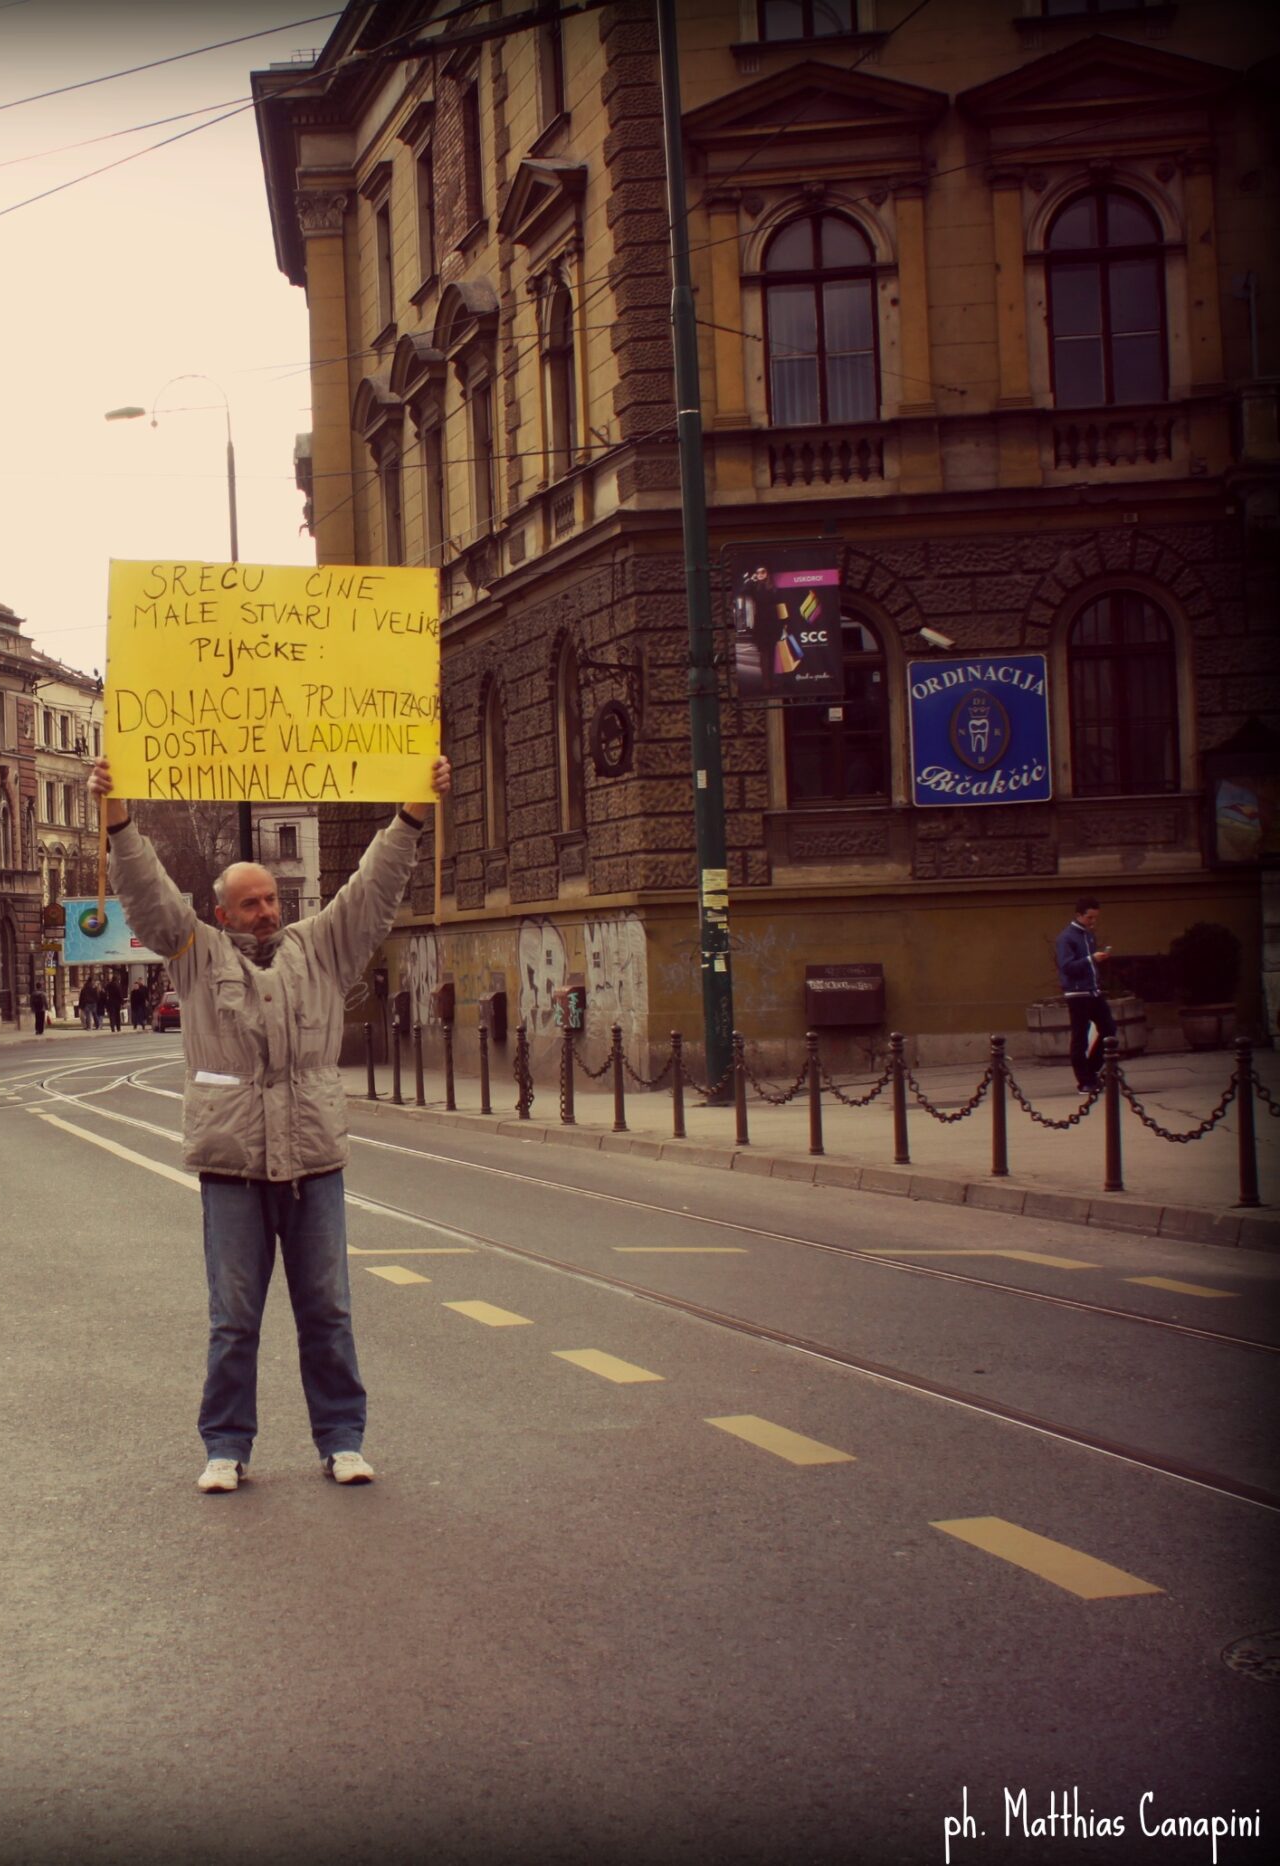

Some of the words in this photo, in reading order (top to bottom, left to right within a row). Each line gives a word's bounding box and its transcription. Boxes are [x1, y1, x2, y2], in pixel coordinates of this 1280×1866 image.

[143, 561, 264, 600] SREĆU
[304, 564, 385, 600] ČINE
[133, 601, 218, 629] MALE
[240, 602, 330, 630] STVARI
[351, 608, 357, 632] I
[800, 631, 828, 643] SCC
[912, 665, 1046, 700] ORDINACIJA
[145, 729, 228, 762] DOSTA
[238, 725, 267, 753] JE
[279, 723, 421, 755] VLADAVINE
